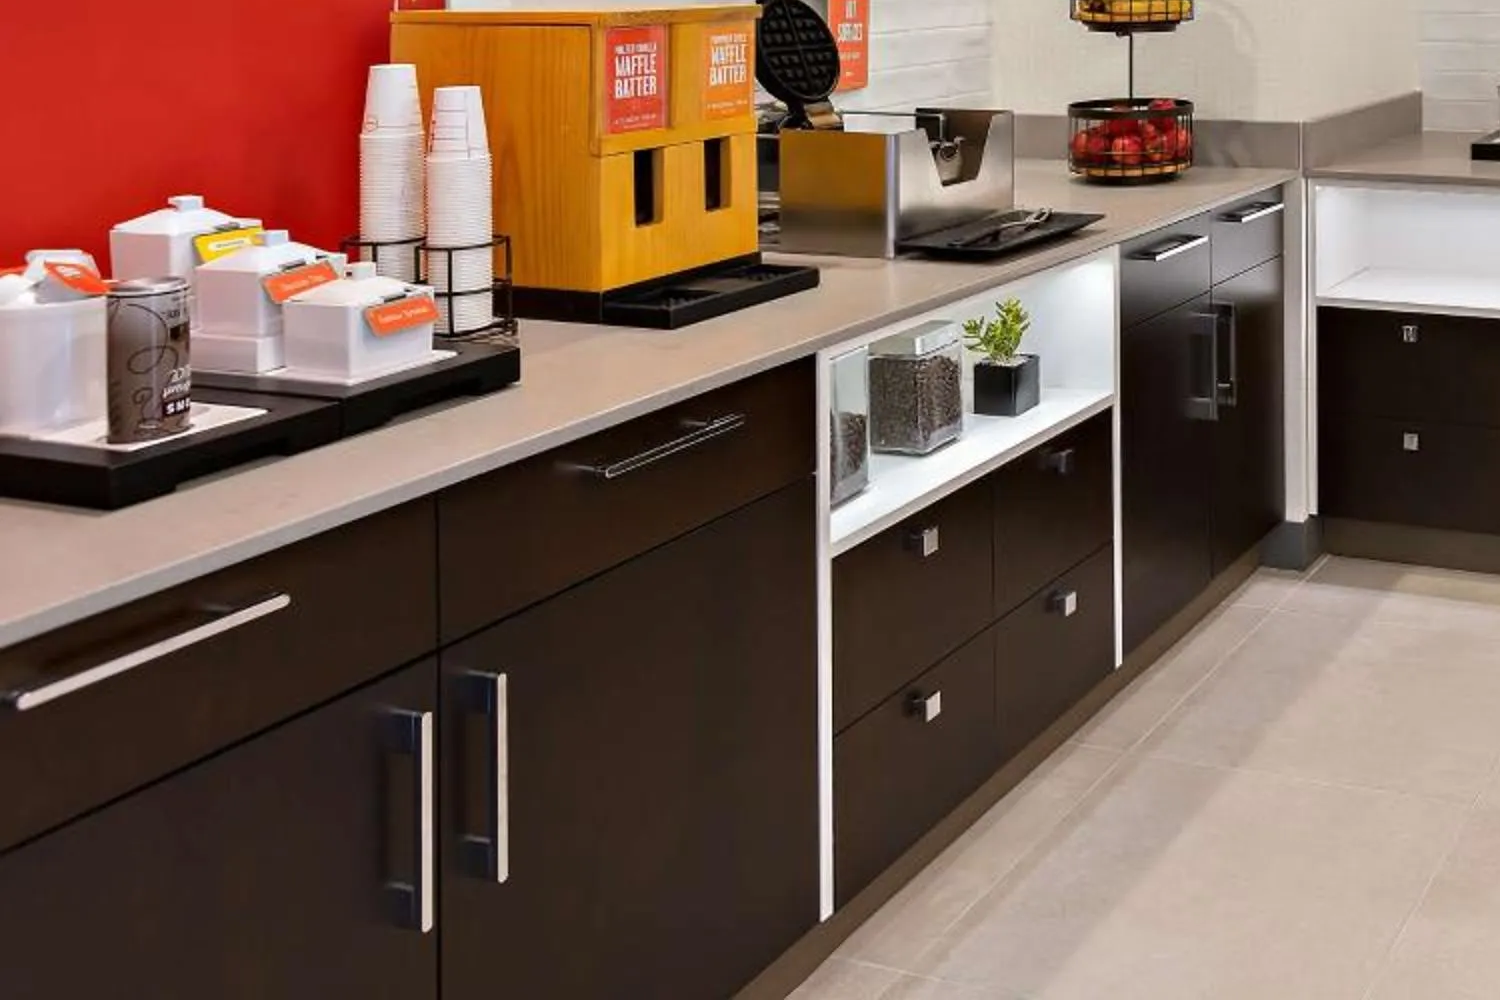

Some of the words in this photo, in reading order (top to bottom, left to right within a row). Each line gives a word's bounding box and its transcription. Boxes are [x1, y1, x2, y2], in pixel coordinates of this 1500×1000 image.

[615, 53, 657, 77] WAFFLE
[711, 43, 747, 66] WAFFLE
[615, 75, 657, 99] BATTER
[709, 63, 747, 87] BATTER
